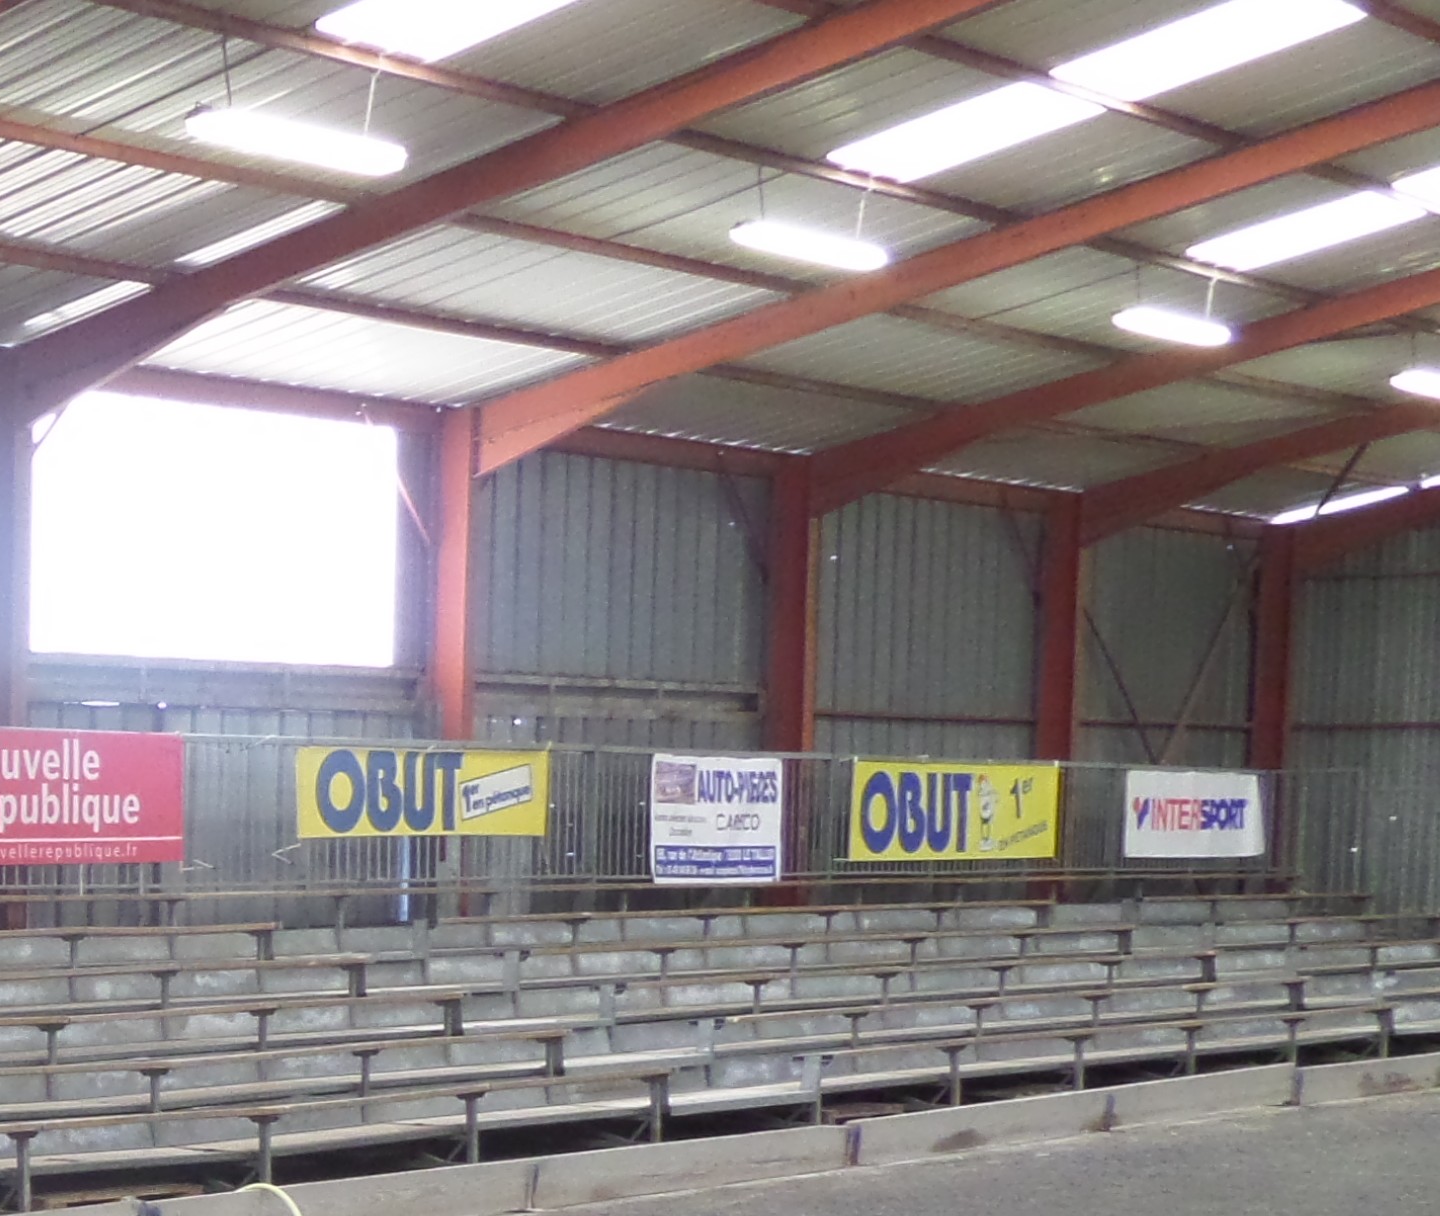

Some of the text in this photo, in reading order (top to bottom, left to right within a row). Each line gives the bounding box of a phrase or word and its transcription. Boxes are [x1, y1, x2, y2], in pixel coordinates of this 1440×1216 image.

[316, 749, 465, 833] OBUT
[861, 770, 973, 854] OBUT
[1151, 798, 1247, 831] INTERSPORT
